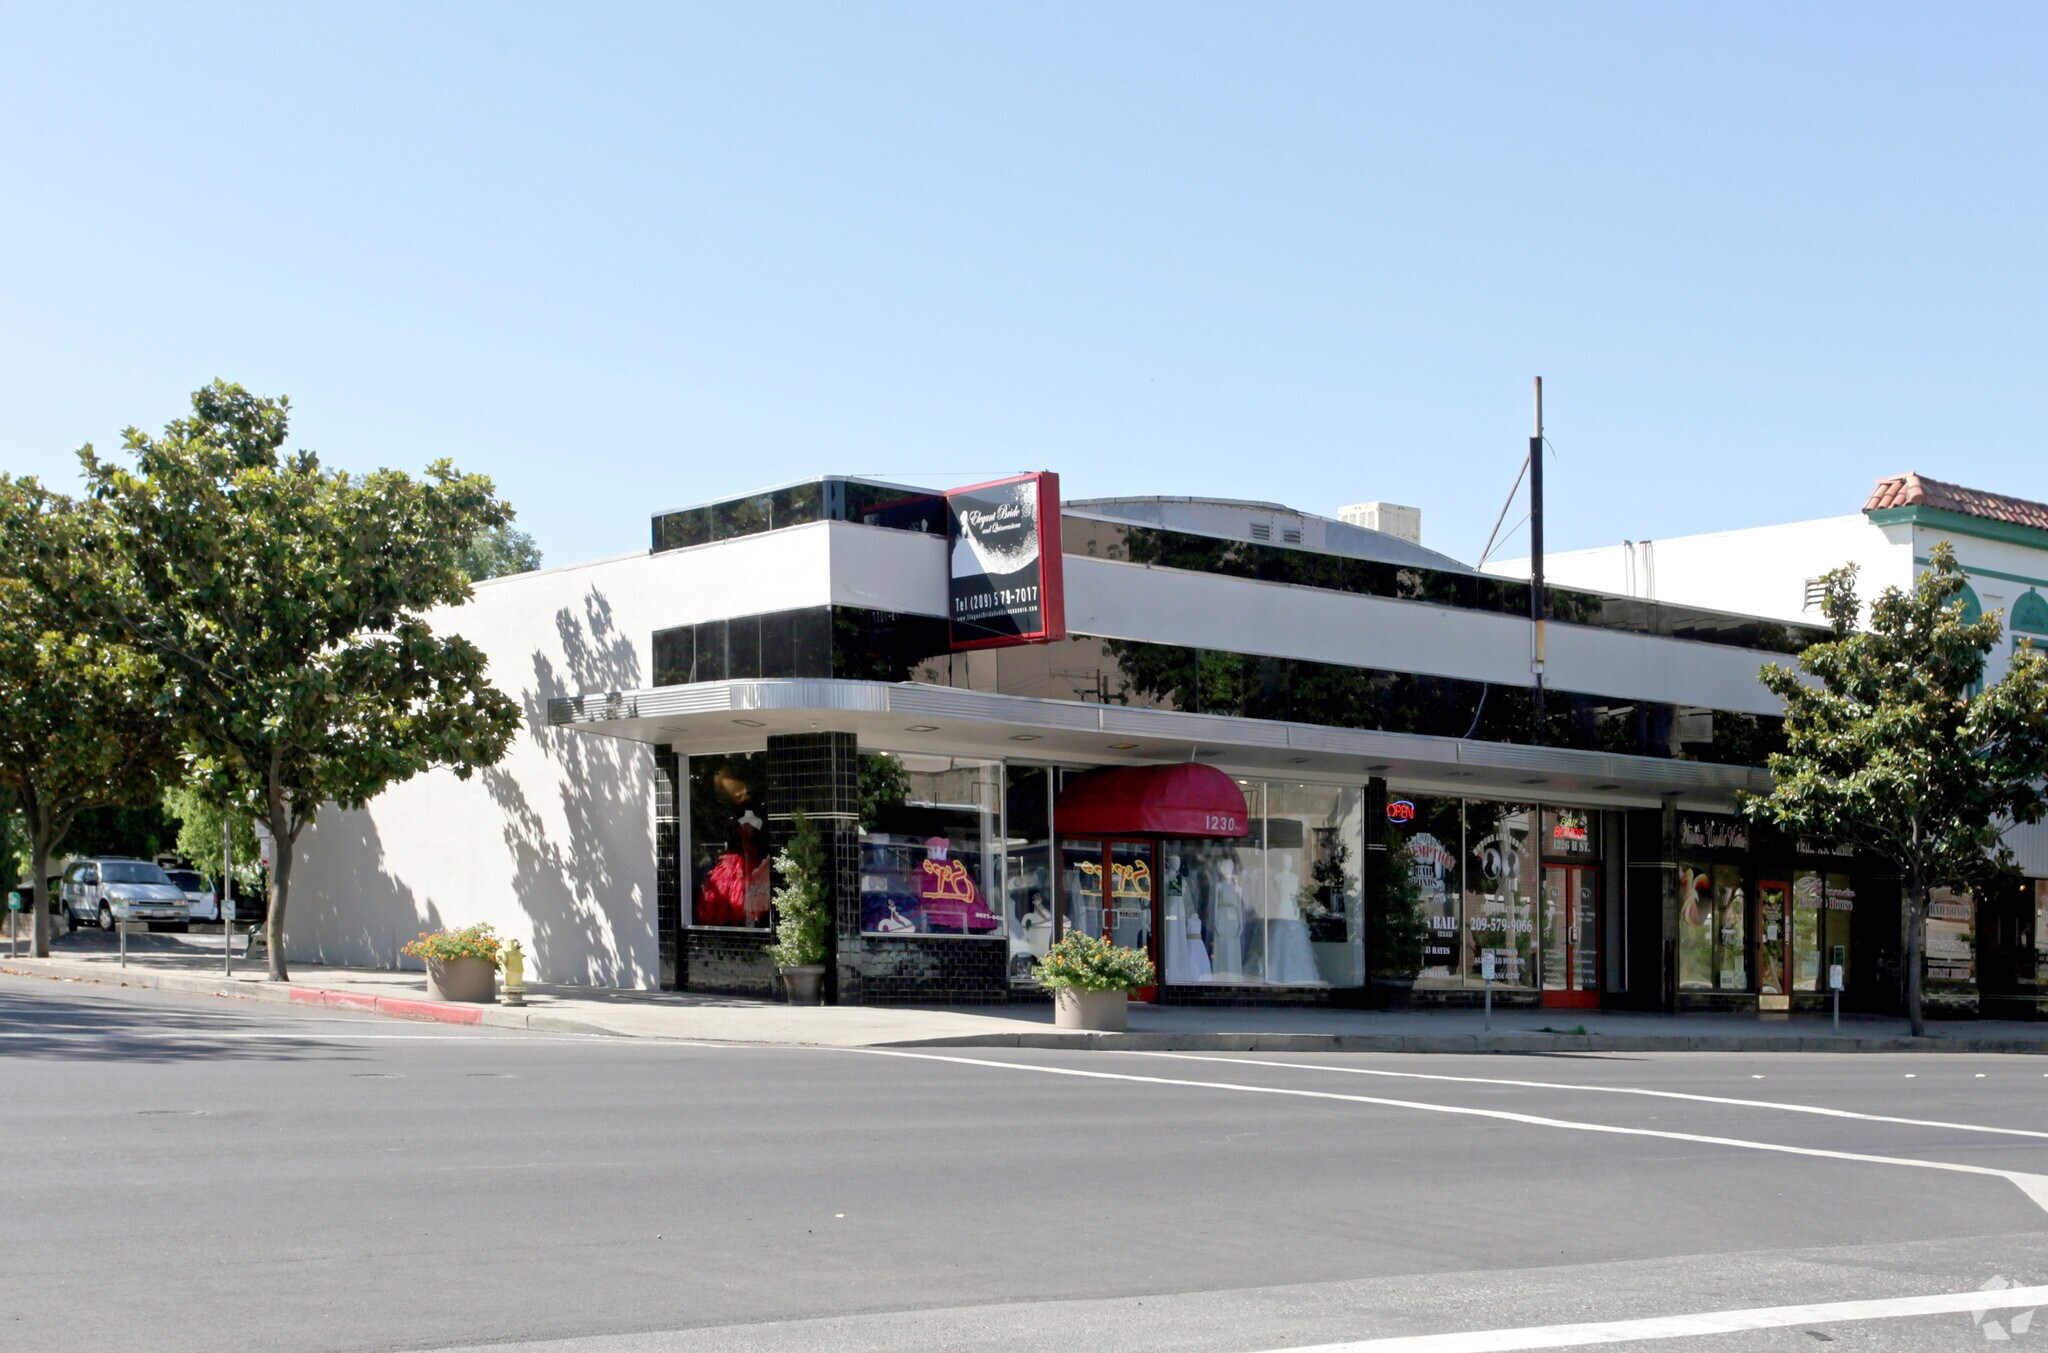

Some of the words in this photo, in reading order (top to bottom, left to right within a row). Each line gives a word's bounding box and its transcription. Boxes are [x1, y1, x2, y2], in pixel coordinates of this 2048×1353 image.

[969, 510, 996, 530] Elegant
[996, 504, 1021, 520] Bride
[981, 526, 992, 535] and
[955, 596, 968, 612] Tel
[970, 593, 992, 611] (209)
[1386, 803, 1415, 819] OPEN
[1205, 815, 1235, 831] 1230
[1560, 816, 1579, 828] BAIL
[1553, 826, 1585, 839] BONDS
[1553, 839, 1570, 850] 1226
[1571, 841, 1578, 851] H
[1579, 841, 1591, 852] ST.
[1415, 865, 1434, 877] BAIL
[1433, 916, 1457, 930] BAIL
[1432, 946, 1450, 955] HAYES
